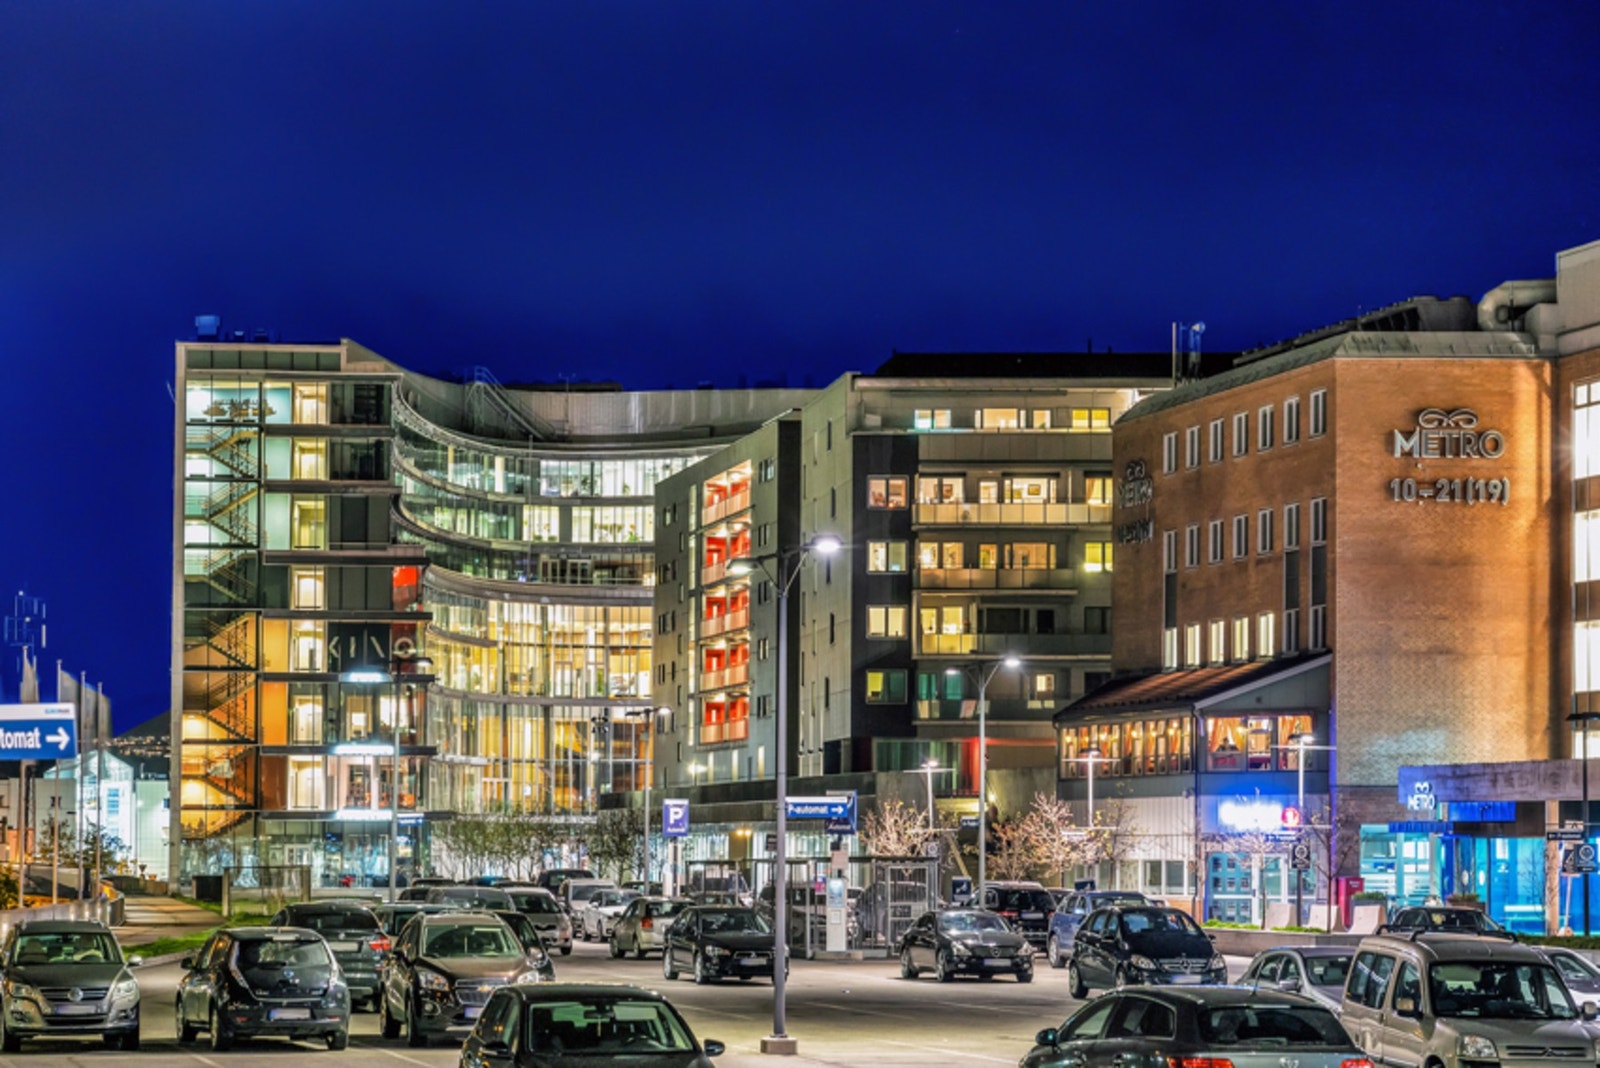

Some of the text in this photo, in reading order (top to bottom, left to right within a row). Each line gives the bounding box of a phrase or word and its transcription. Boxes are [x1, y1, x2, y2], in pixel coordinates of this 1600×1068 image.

[1394, 426, 1505, 459] METRO
[669, 807, 684, 825] P
[788, 803, 829, 816] P-automat
